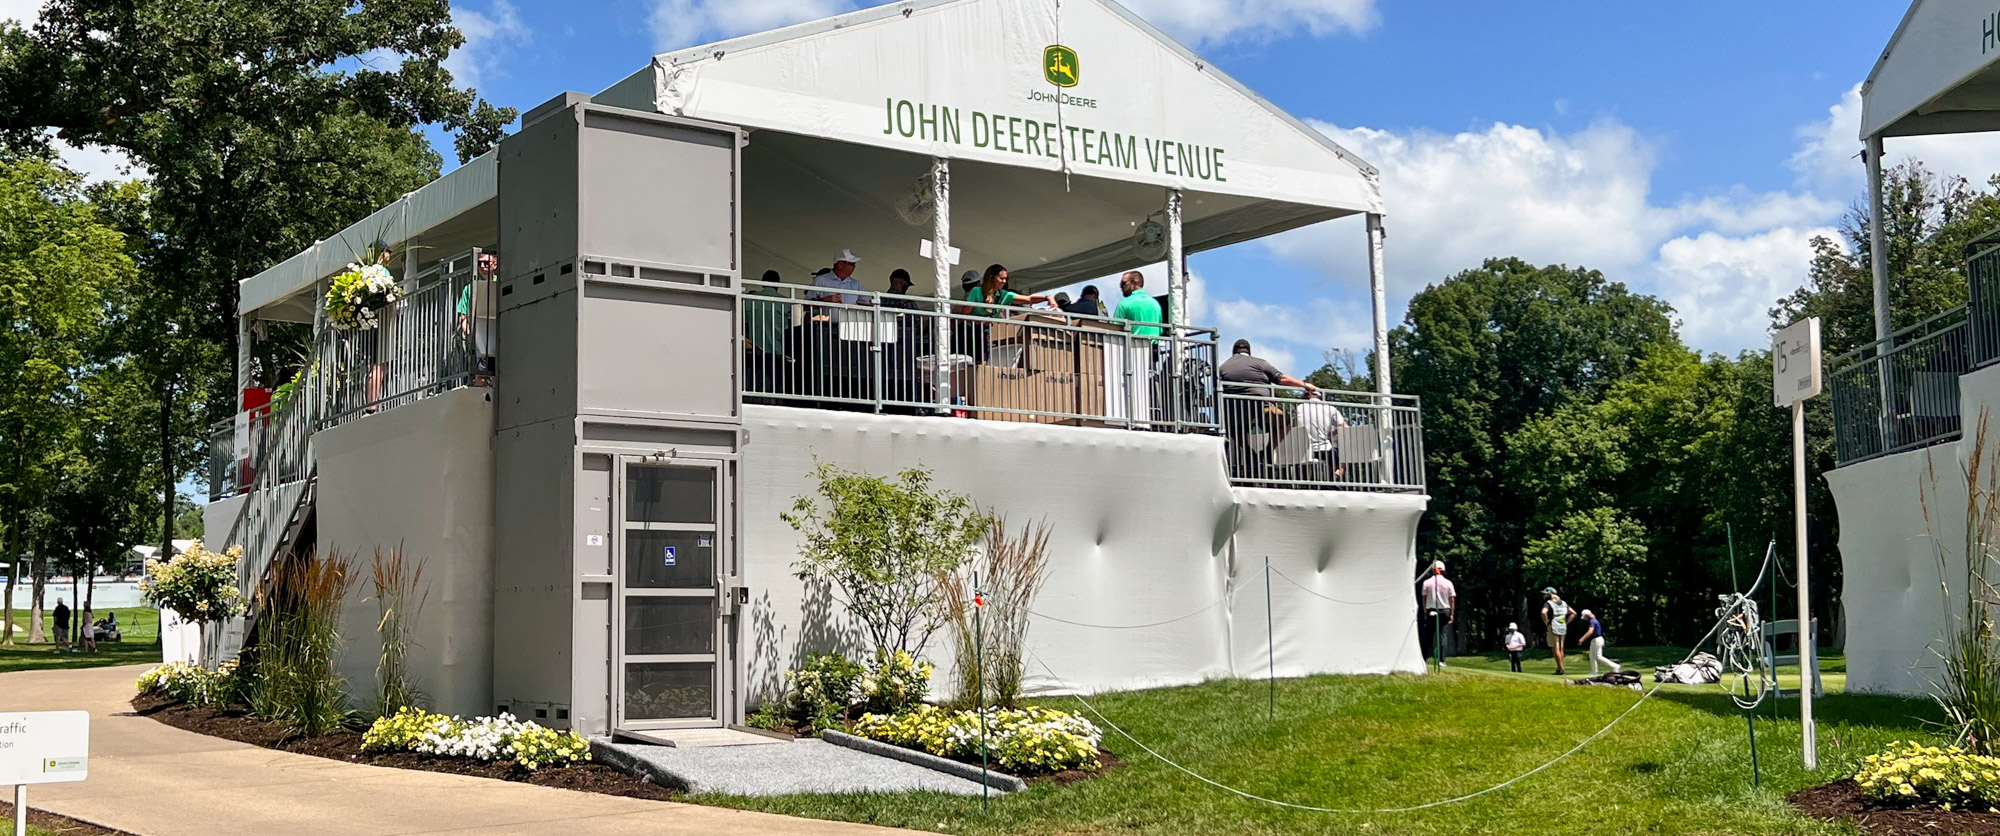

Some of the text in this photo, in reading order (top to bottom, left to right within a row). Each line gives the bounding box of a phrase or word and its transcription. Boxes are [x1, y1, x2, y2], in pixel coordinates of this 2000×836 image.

[1982, 10, 2000, 55] H
[1027, 89, 1097, 109] JOHN DEERE
[883, 97, 1227, 182] JOHN DEERE TEAM VENUE
[1775, 340, 1788, 375] 15
